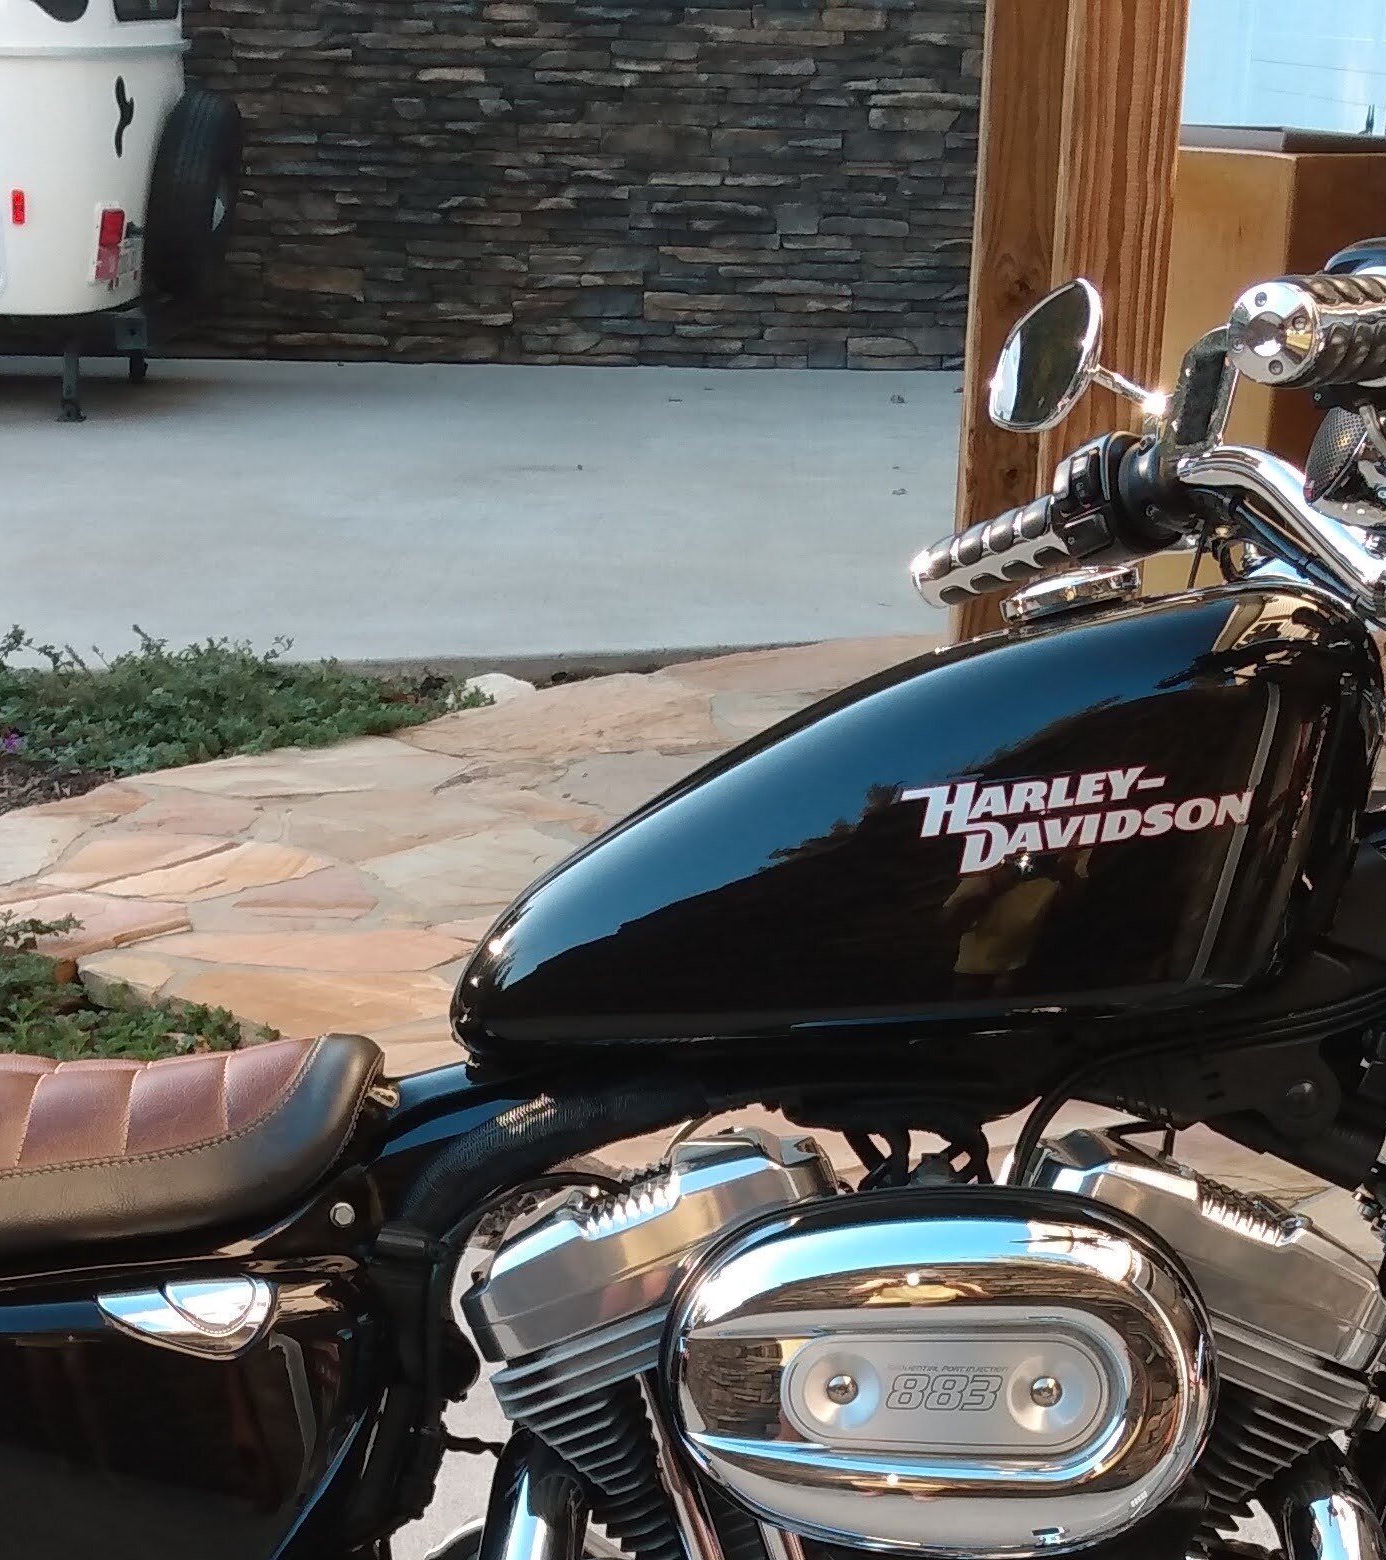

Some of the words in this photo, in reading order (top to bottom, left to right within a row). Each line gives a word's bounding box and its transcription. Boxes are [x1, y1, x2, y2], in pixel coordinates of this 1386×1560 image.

[900, 766, 1167, 838] HARLEY-
[959, 790, 1254, 875] DAVIDSON
[886, 1373, 1004, 1412] 883
